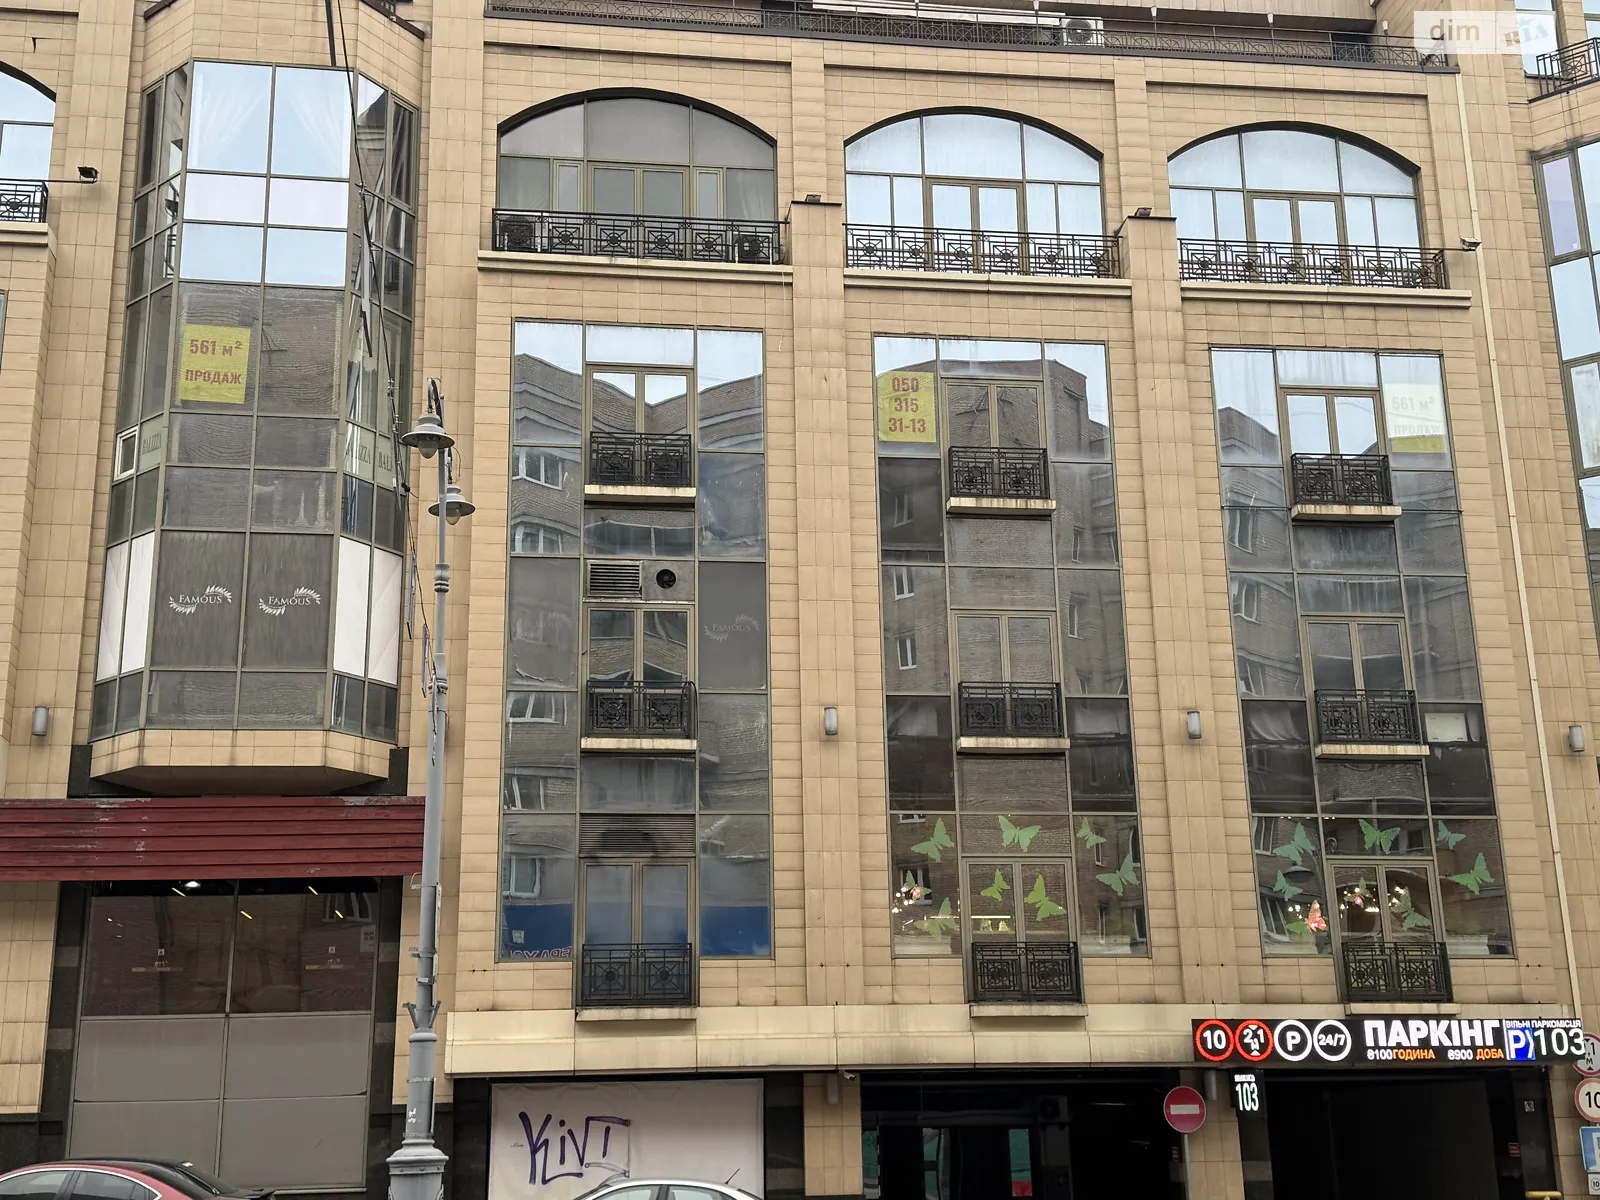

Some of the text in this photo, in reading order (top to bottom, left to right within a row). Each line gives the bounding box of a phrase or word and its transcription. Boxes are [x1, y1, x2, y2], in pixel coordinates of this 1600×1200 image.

[190, 339, 217, 355] 561
[185, 369, 241, 384] ПРОДАЖ
[891, 377, 920, 393] 050
[894, 397, 919, 412] 315
[1391, 396, 1415, 411] 561
[888, 417, 926, 433] 31-13
[1505, 1020, 1530, 1028] ВІЛЬНІ
[1203, 1030, 1226, 1049] 10
[1318, 1034, 1346, 1046] 24/7
[1363, 1019, 1500, 1046] ПАРКІНГ
[1286, 1031, 1300, 1051] P
[1534, 1028, 1586, 1055] 103
[1476, 1049, 1504, 1060] ДОБА
[1235, 1082, 1259, 1111] 103
